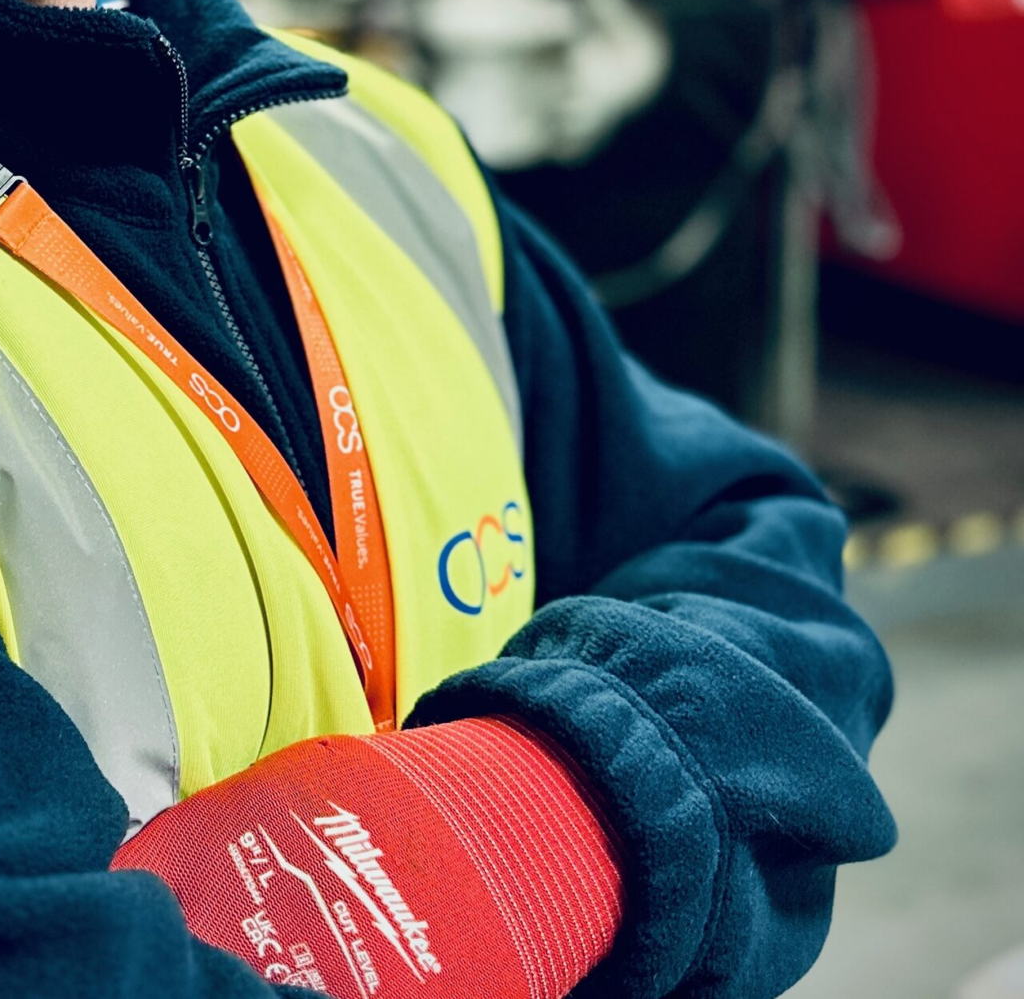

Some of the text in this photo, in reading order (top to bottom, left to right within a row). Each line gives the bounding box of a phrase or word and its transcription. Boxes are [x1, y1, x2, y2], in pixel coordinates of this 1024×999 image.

[189, 372, 240, 433] OCS
[329, 385, 363, 453] OCS
[438, 501, 525, 615] OCS
[314, 800, 440, 974] Milwaukee
[333, 900, 380, 995] CUT LEVEL
